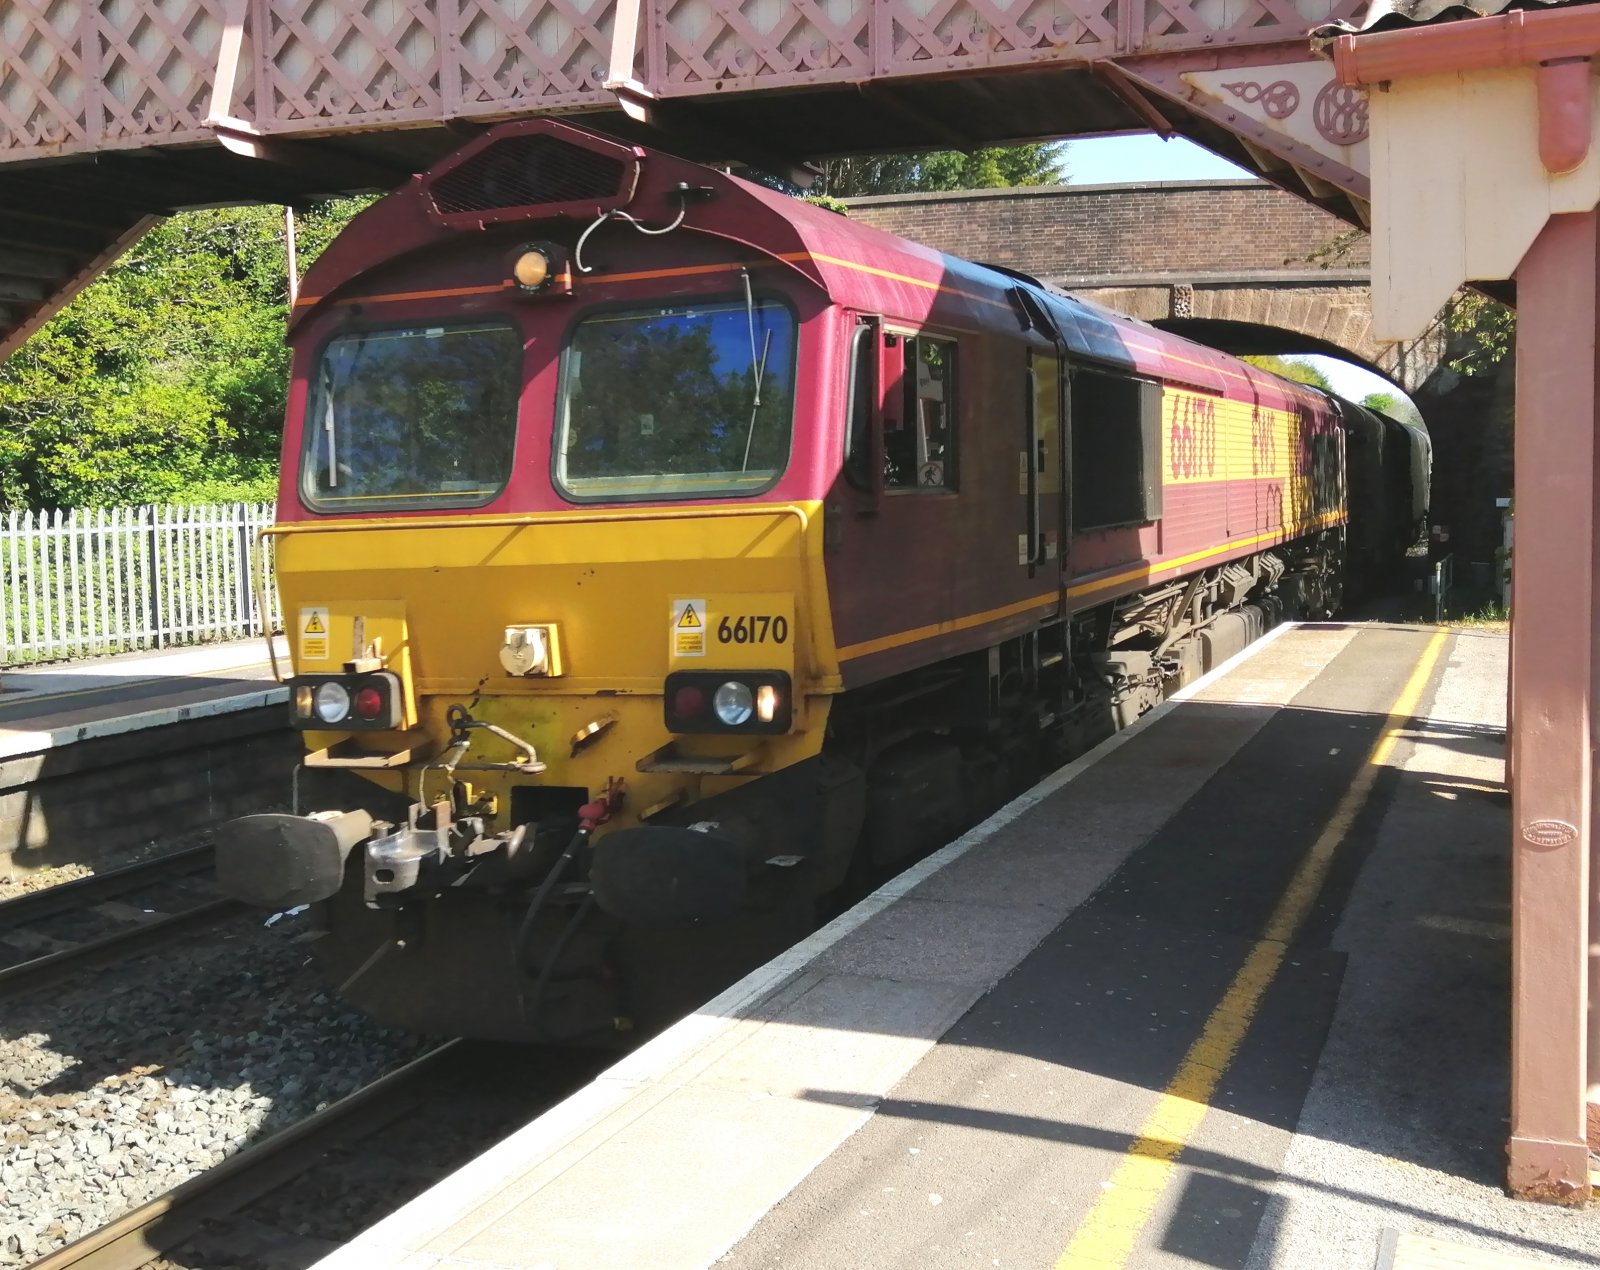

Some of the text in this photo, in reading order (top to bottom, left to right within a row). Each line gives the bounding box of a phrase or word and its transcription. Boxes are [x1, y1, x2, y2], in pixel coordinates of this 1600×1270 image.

[1171, 394, 1215, 480] 66170
[1252, 409, 1276, 476] EWS
[717, 615, 788, 645] 66170
